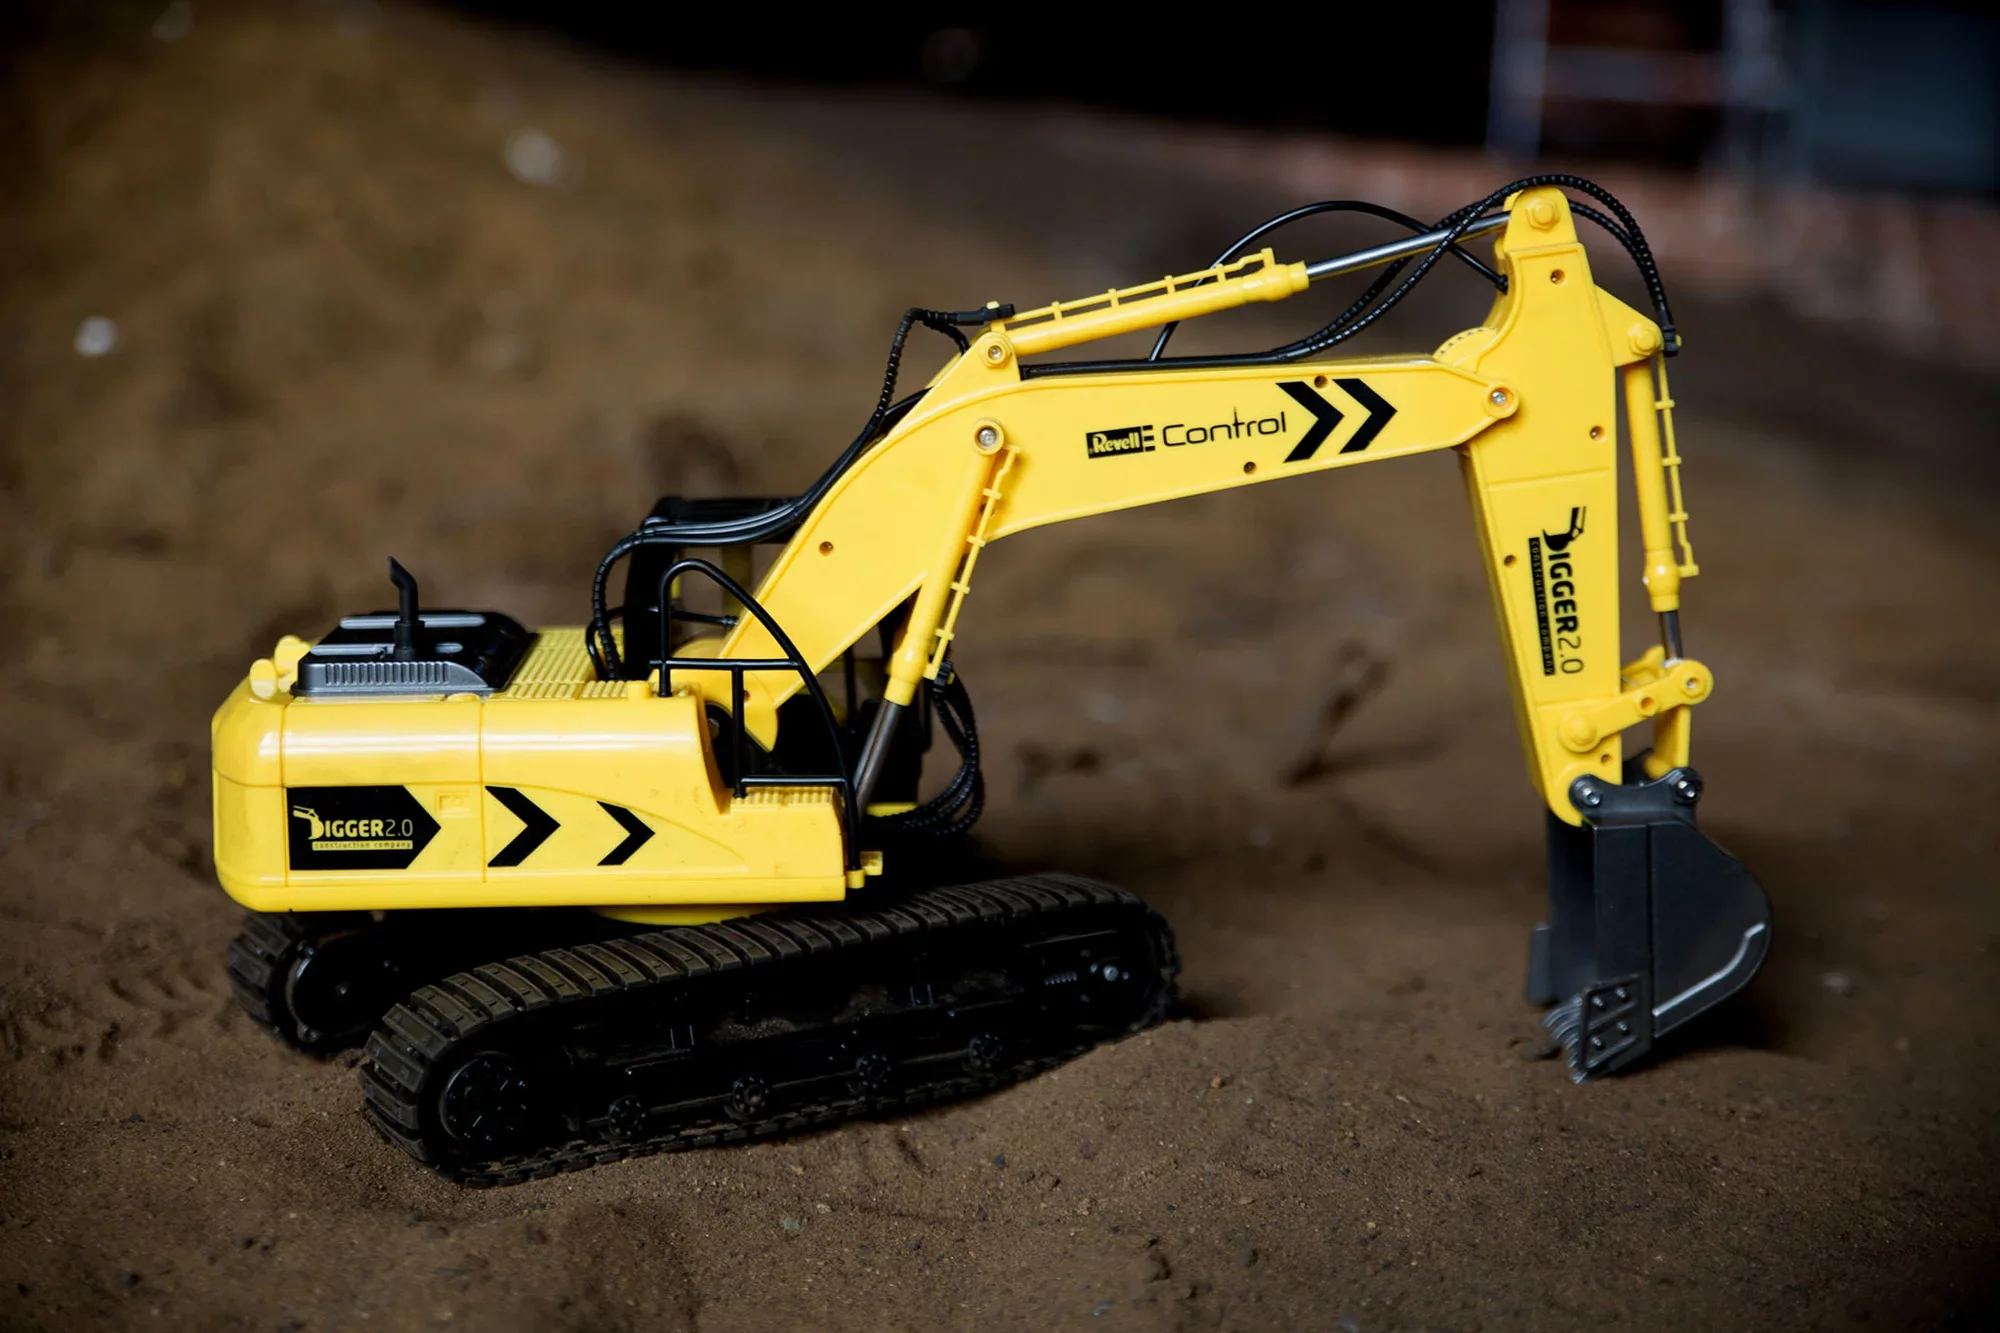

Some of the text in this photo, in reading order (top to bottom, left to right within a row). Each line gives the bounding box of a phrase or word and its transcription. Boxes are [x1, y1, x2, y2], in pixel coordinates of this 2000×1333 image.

[1091, 407, 1287, 454] Revell Control
[1531, 540, 1552, 674] construction company
